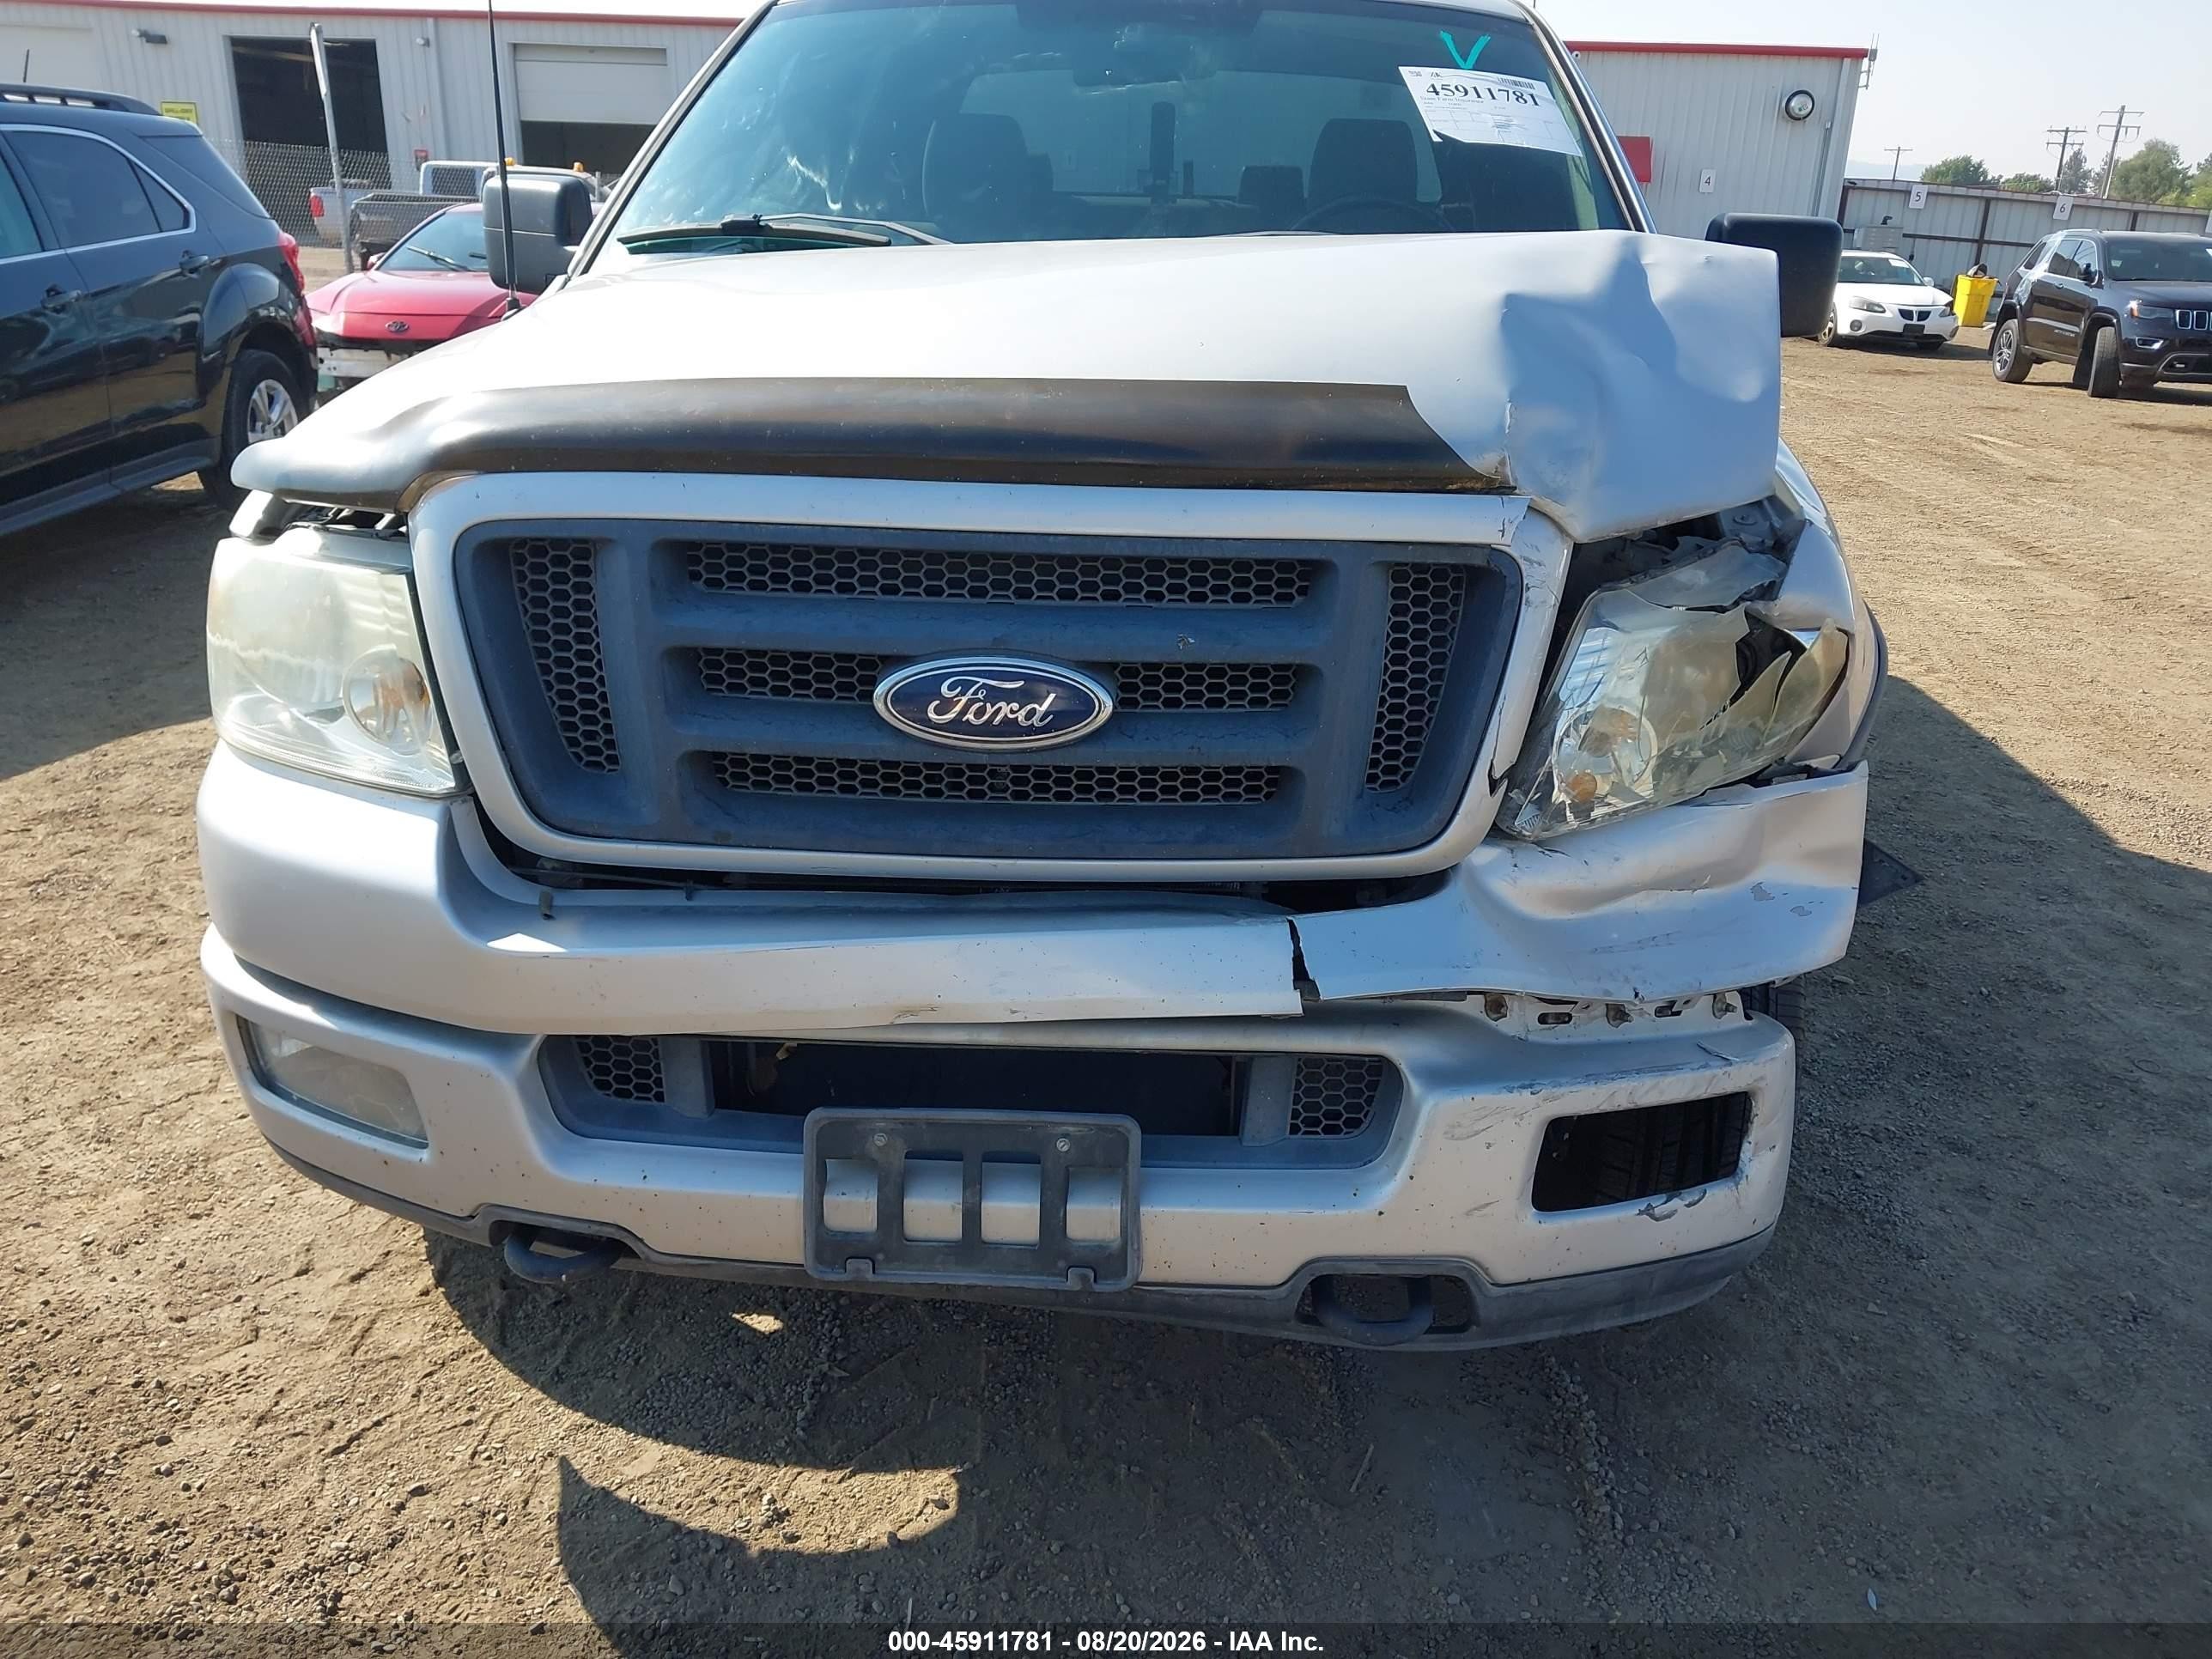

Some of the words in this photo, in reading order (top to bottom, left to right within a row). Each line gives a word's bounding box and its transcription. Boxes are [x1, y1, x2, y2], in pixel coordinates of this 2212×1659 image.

[1426, 82, 1541, 107] 45911781
[1704, 175, 1711, 186] 4
[1915, 191, 1922, 203] 5
[2059, 203, 2066, 214] 6
[927, 675, 1056, 727] Ford
